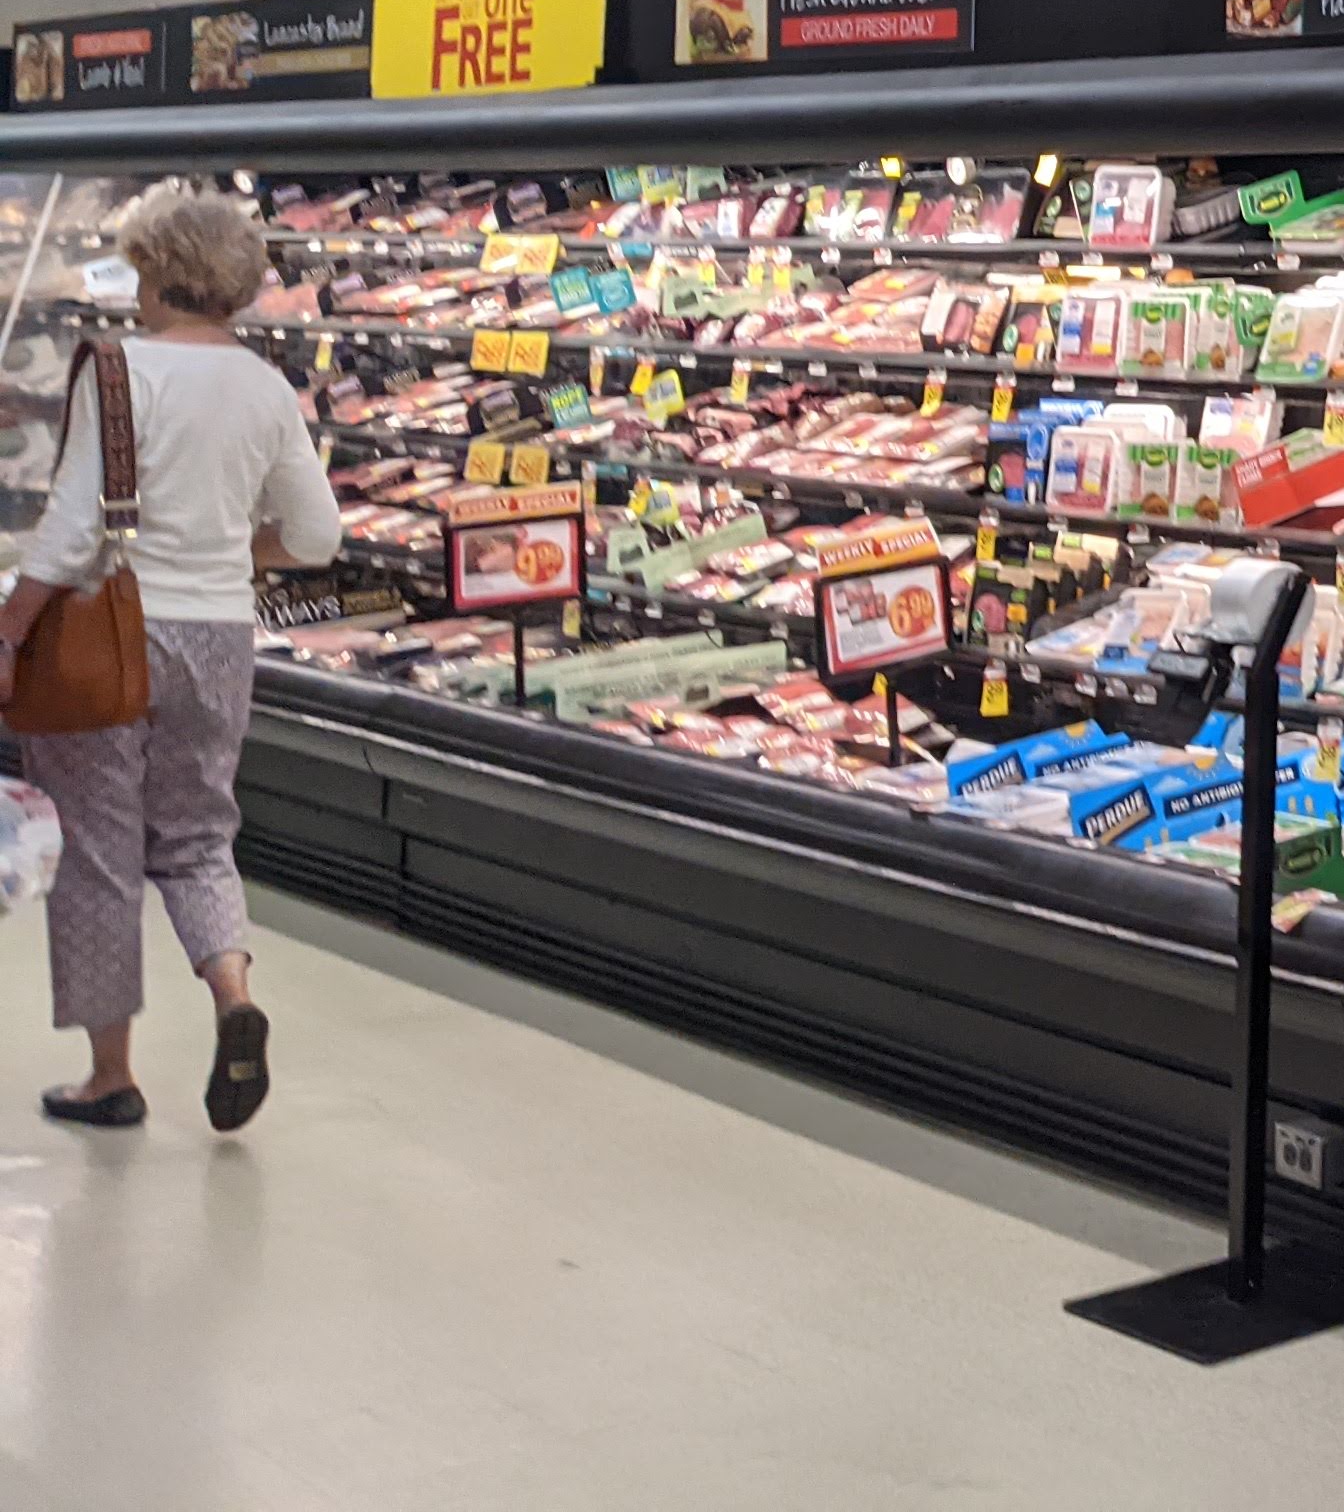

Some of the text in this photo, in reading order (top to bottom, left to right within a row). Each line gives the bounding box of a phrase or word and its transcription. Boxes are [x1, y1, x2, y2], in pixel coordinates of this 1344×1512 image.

[431, 4, 534, 92] FREE
[800, 14, 936, 43] GROUND FRESH DAILY
[822, 529, 929, 567] WEEKLY SPECIAL
[958, 755, 1020, 798] PERDUE
[1083, 789, 1149, 838] PERDUE
[1169, 782, 1244, 814] NO ANTIBIO
